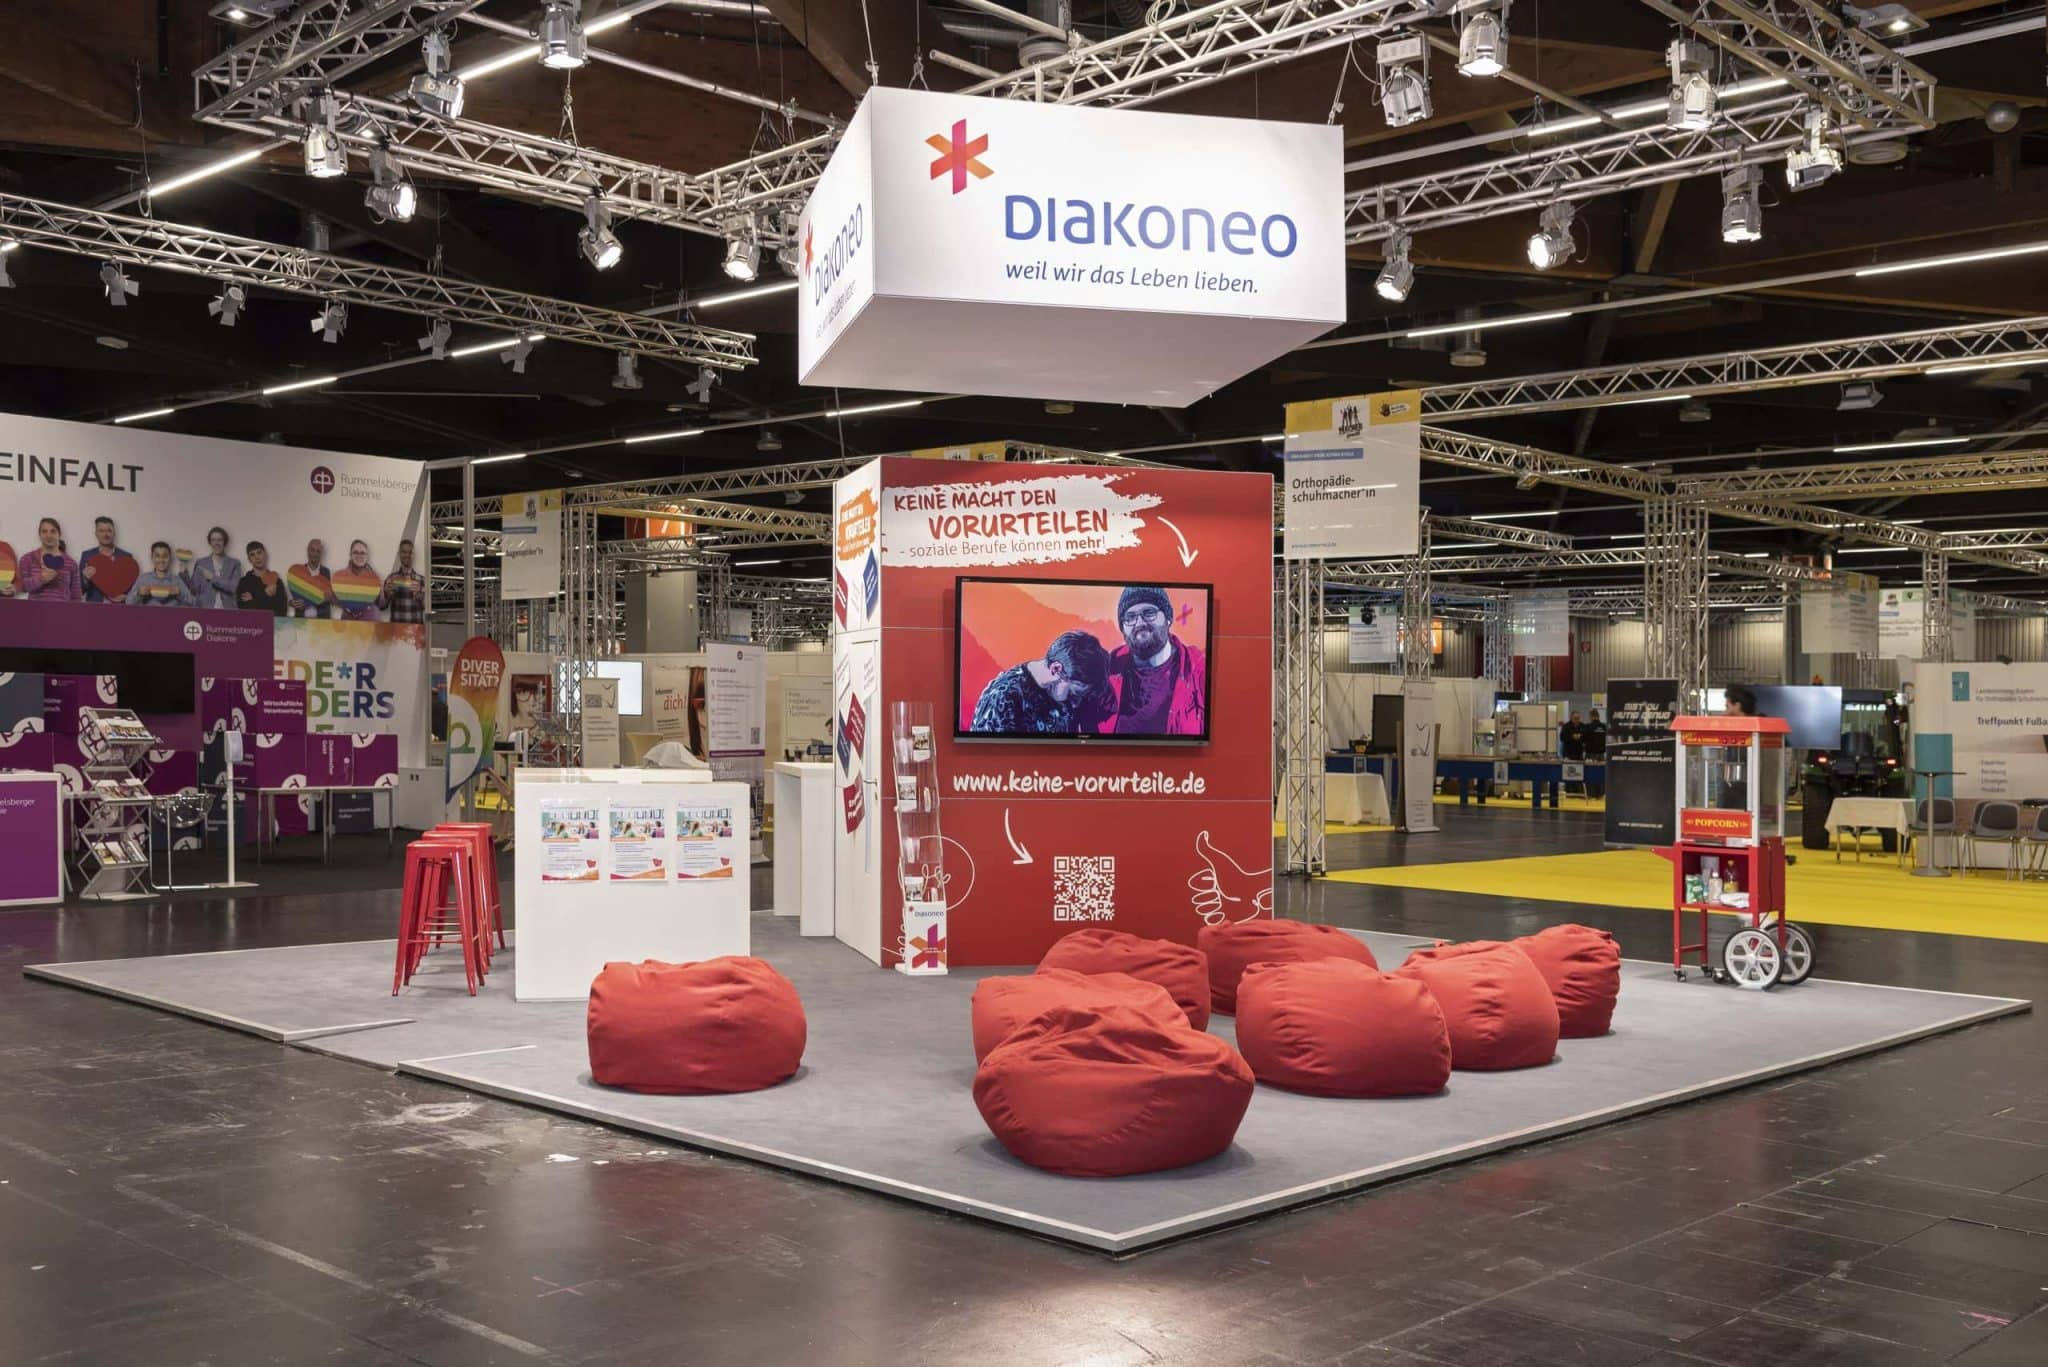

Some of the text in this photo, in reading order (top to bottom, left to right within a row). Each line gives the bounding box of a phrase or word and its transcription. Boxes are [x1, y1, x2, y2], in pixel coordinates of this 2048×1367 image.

[1006, 261, 1259, 294] weil wir das Leben lieben.
[1292, 474, 1355, 489] Orthopädie-
[894, 489, 1056, 511] KEINE MACHT DEN
[929, 508, 1108, 540] VORURTEILEN
[910, 542, 957, 557] soziale
[962, 539, 1007, 555] Berufe
[1012, 538, 1061, 553] können
[1065, 535, 1105, 550] mehr!
[461, 659, 499, 674] DIVER
[664, 694, 687, 711] dich!
[1977, 716, 2023, 727] Treffpunkt
[953, 770, 1206, 794] www.keine-vorurteile.de
[1695, 818, 1739, 828] POPCORN
